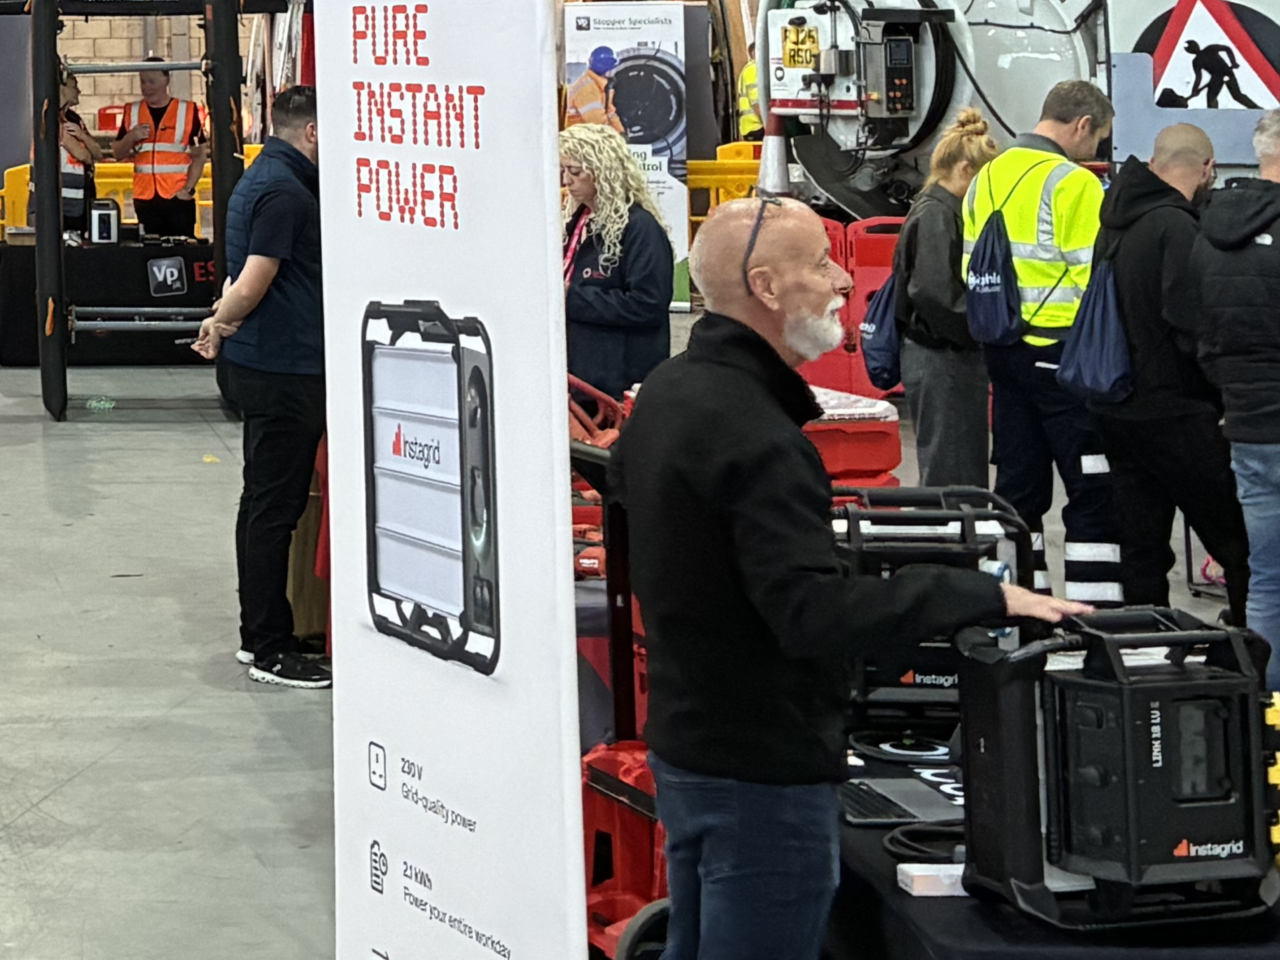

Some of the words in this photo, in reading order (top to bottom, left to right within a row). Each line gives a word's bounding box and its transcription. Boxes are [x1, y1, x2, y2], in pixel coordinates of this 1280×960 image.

[352, 4, 430, 66] PURE
[352, 81, 486, 150] INSTANT
[356, 157, 459, 230] POWER
[153, 265, 178, 286] Vp
[915, 673, 958, 687] instagri
[402, 782, 449, 824] Grid-quality
[450, 809, 477, 833] power
[404, 885, 429, 913] Power
[429, 903, 447, 921] your
[448, 914, 473, 939] entire
